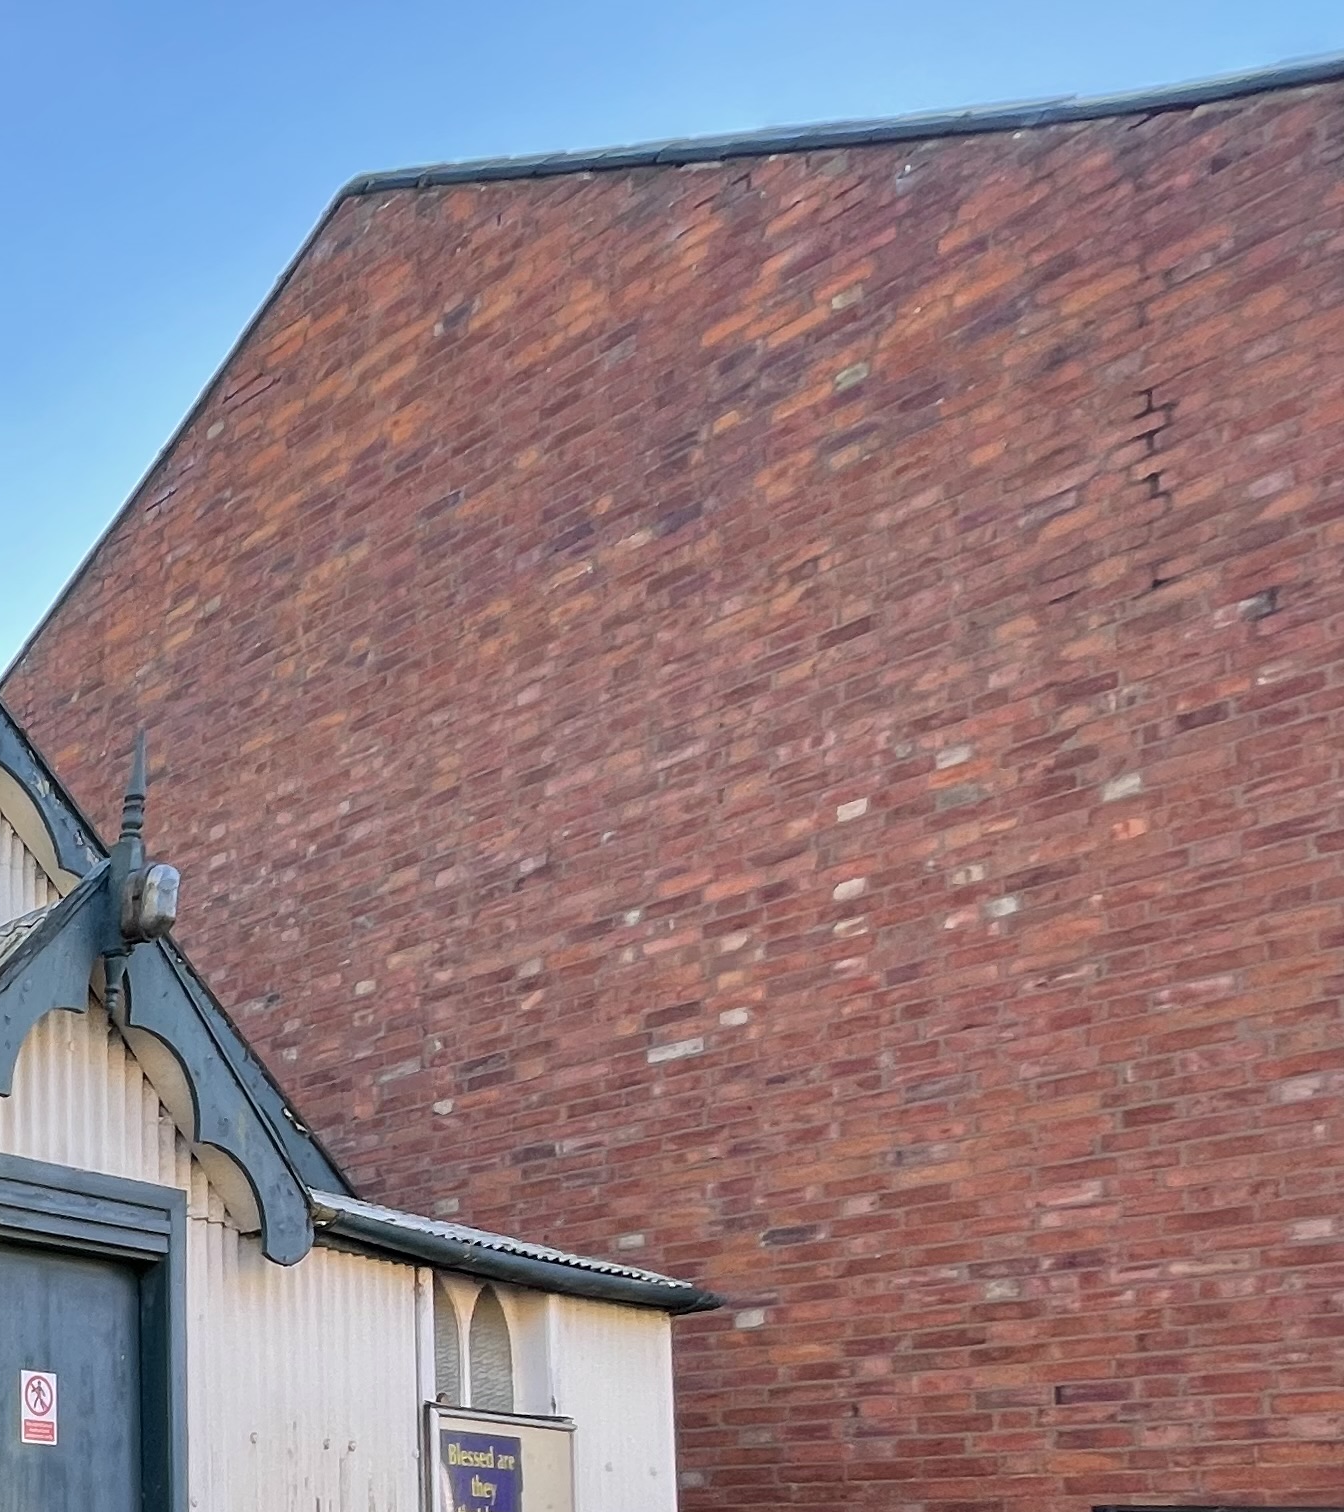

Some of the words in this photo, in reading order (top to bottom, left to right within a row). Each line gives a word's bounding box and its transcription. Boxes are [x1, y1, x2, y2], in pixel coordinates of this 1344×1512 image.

[448, 1442, 495, 1468] Blessed
[497, 1454, 515, 1470] are
[471, 1474, 497, 1506] they
